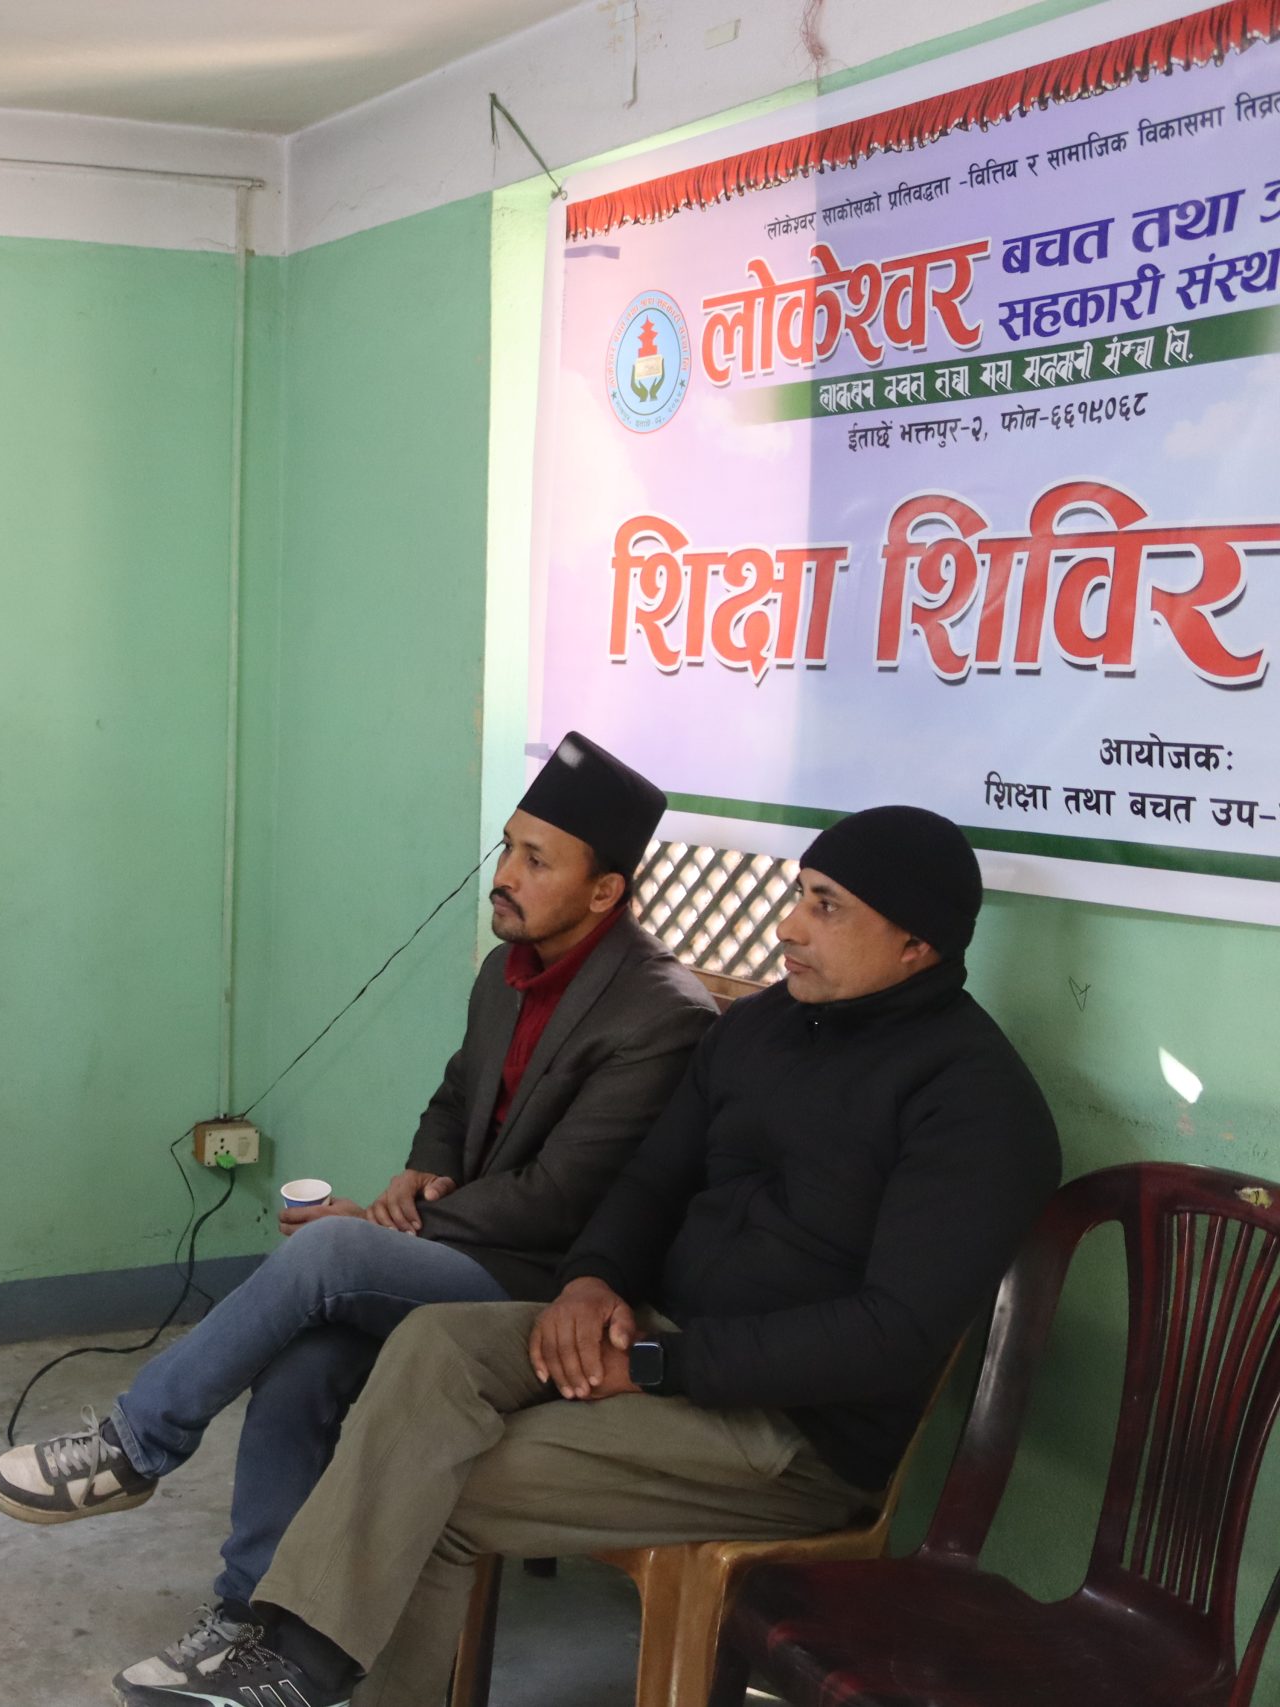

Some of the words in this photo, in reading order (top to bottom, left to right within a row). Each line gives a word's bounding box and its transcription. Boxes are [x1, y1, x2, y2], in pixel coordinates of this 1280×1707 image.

[822, 191, 882, 226] साकोसको
[1026, 153, 1039, 176] र
[1047, 131, 1129, 170] सामाजिक
[1137, 106, 1225, 146] विकासमा
[1002, 216, 1116, 275] बचत
[1132, 188, 1246, 253] तथा
[699, 239, 991, 388] लोकेश्वर
[998, 262, 1166, 342] सहकारी
[609, 513, 850, 687] शिक्षा
[875, 477, 1280, 690] शिविर
[984, 770, 1051, 812] शिक्षा
[1062, 786, 1116, 816] तथा
[1128, 791, 1197, 824] बचत
[1209, 797, 1280, 829] उप-
